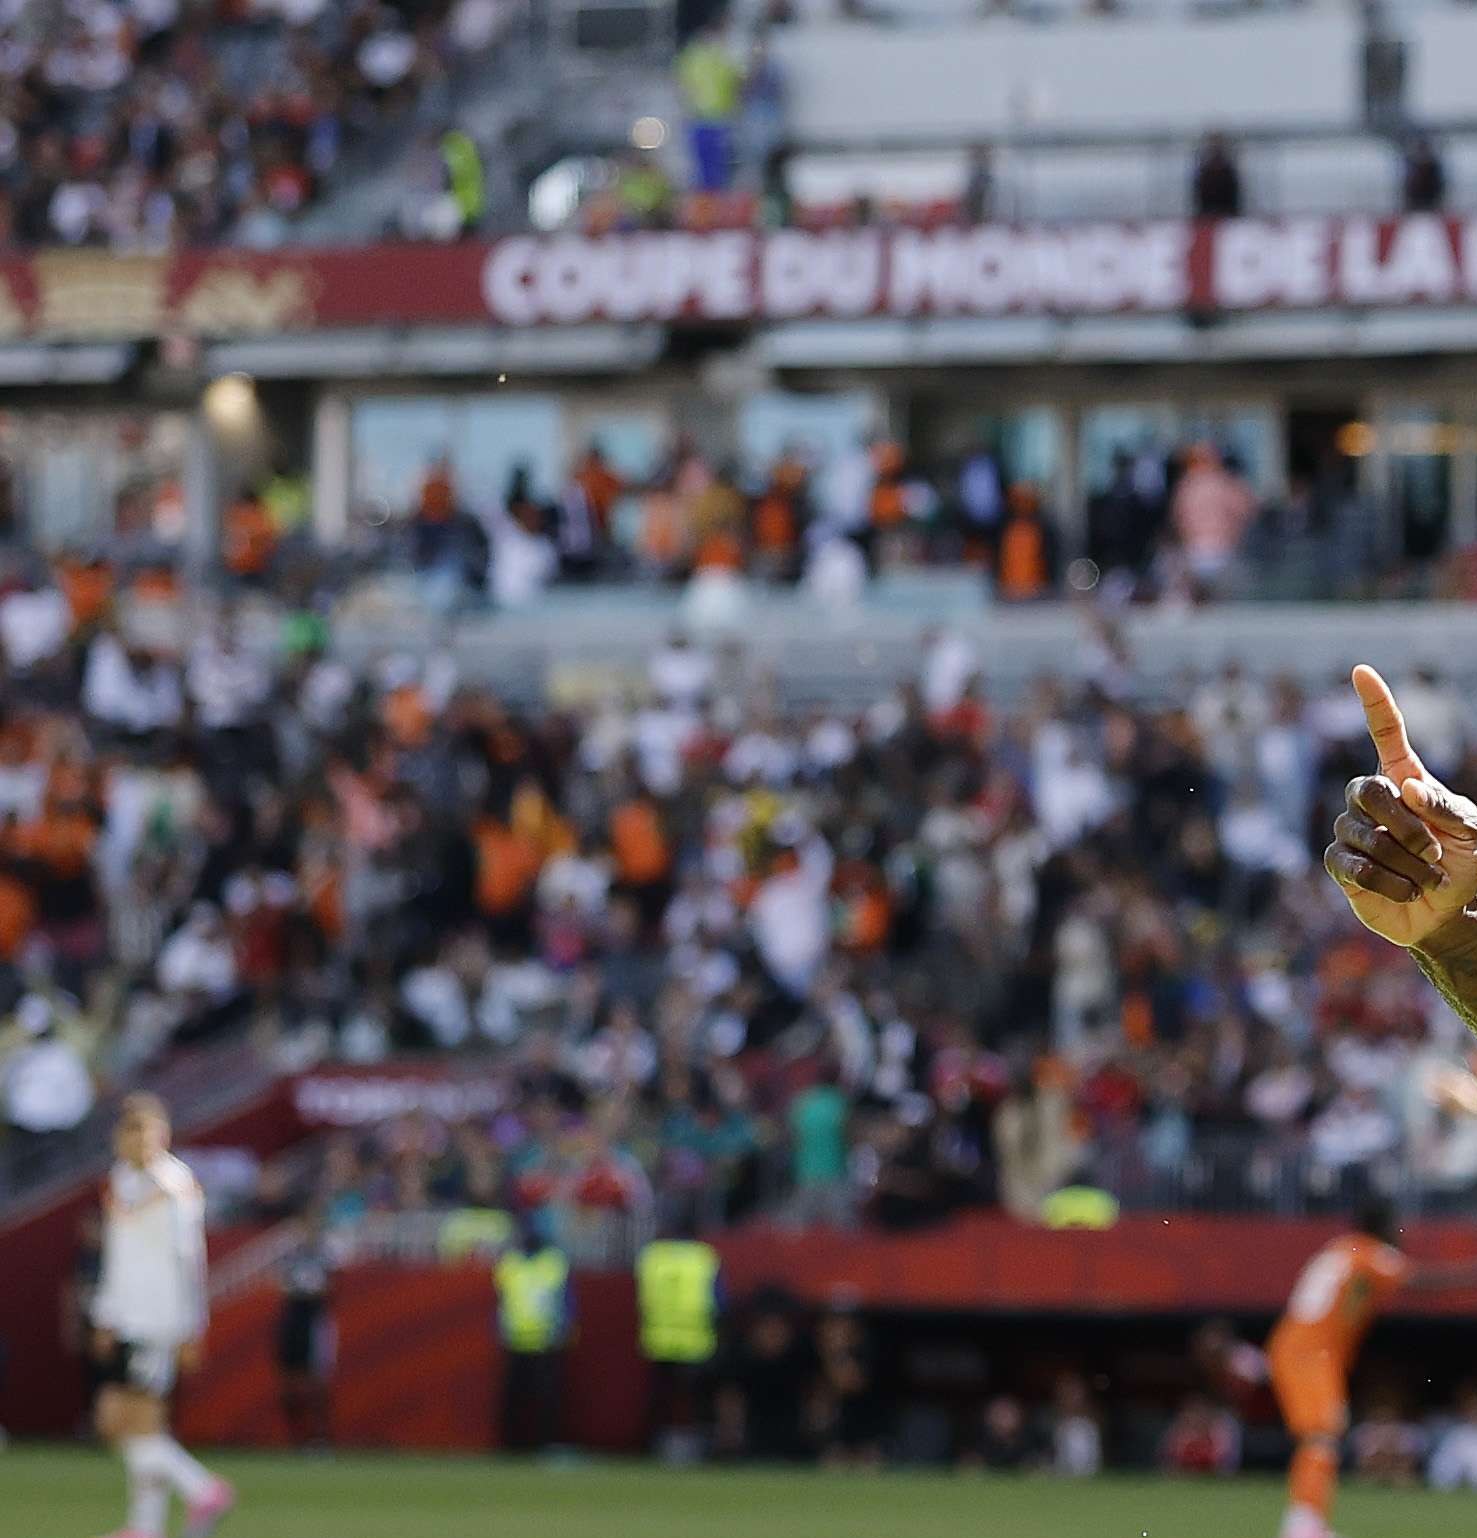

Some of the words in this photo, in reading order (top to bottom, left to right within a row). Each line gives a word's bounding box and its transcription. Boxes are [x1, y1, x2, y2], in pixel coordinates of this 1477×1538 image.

[481, 233, 754, 325] COUPE
[763, 230, 880, 318] DU
[891, 221, 1191, 315] MONDE
[1211, 213, 1331, 307] DE
[1338, 210, 1457, 303] LA
